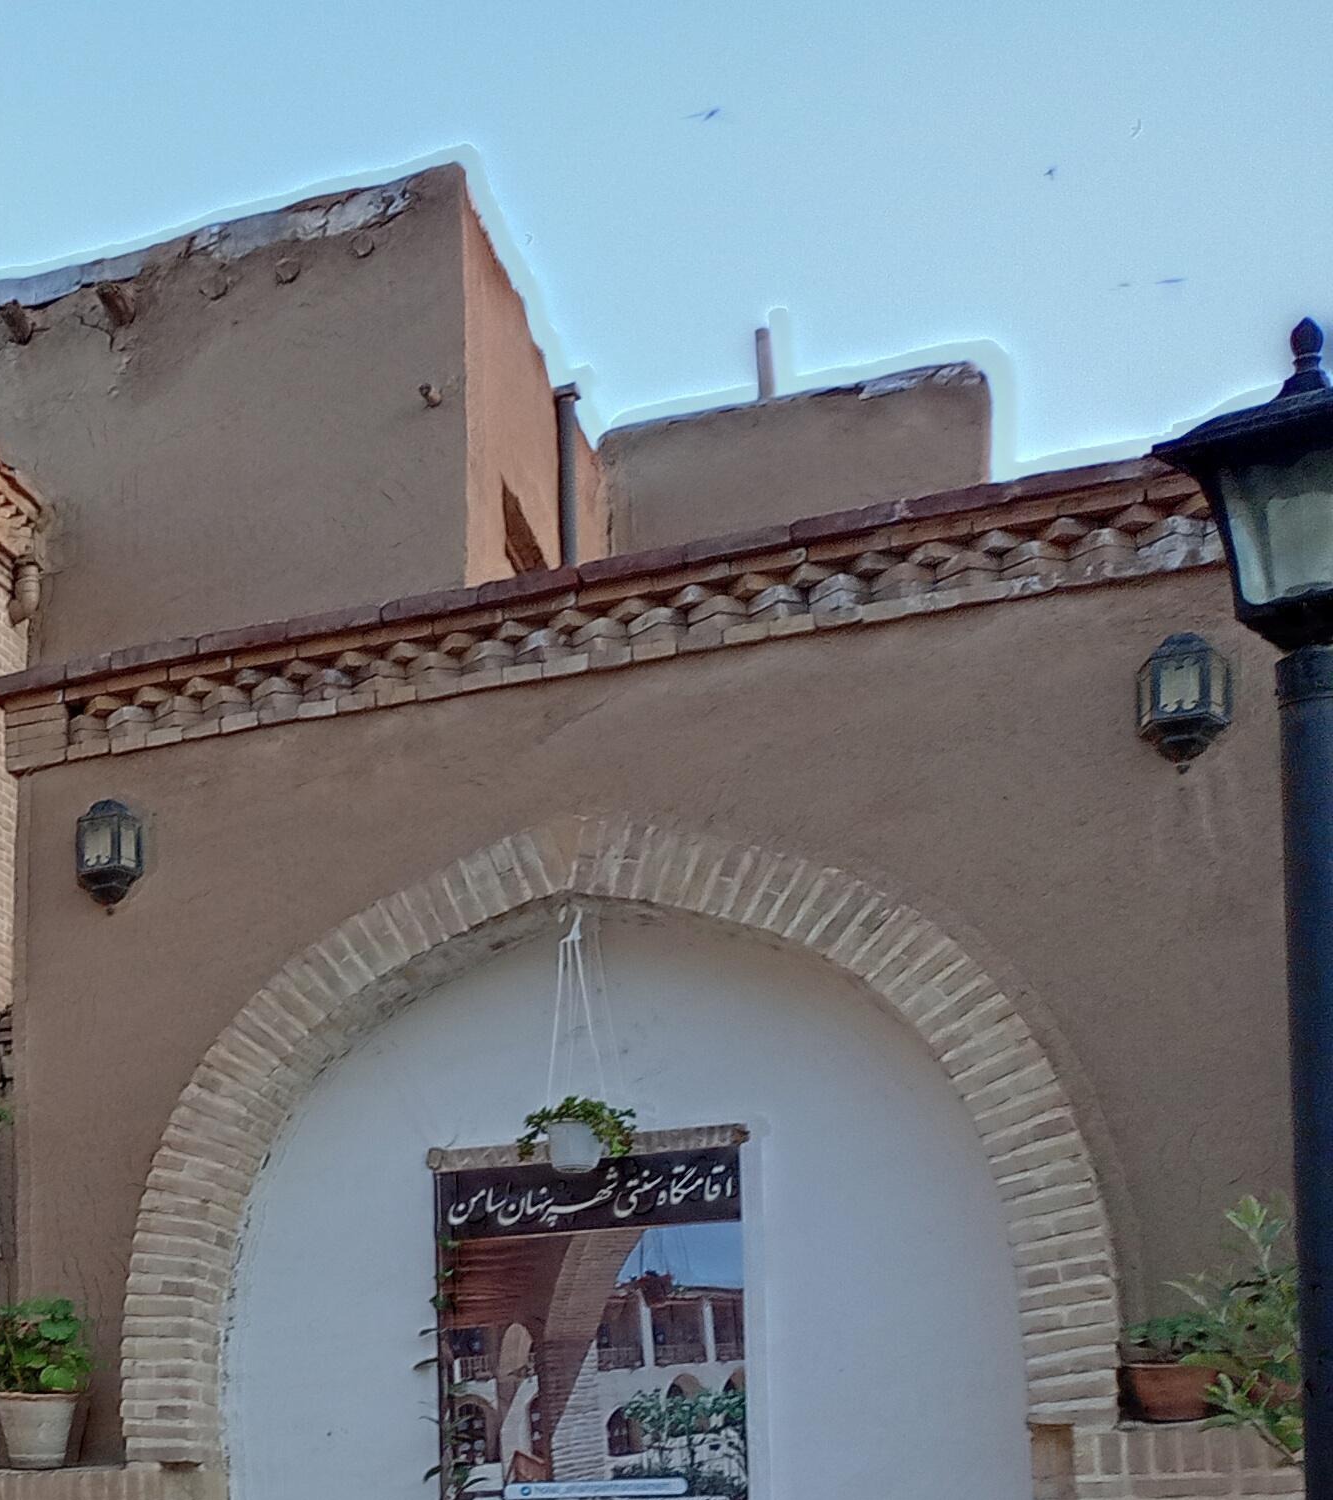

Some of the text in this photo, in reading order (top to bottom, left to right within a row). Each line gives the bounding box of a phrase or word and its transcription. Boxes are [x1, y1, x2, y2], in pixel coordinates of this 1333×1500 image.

[447, 1164, 733, 1228] اقامتگاه سنتی شهر پنهان سامن
